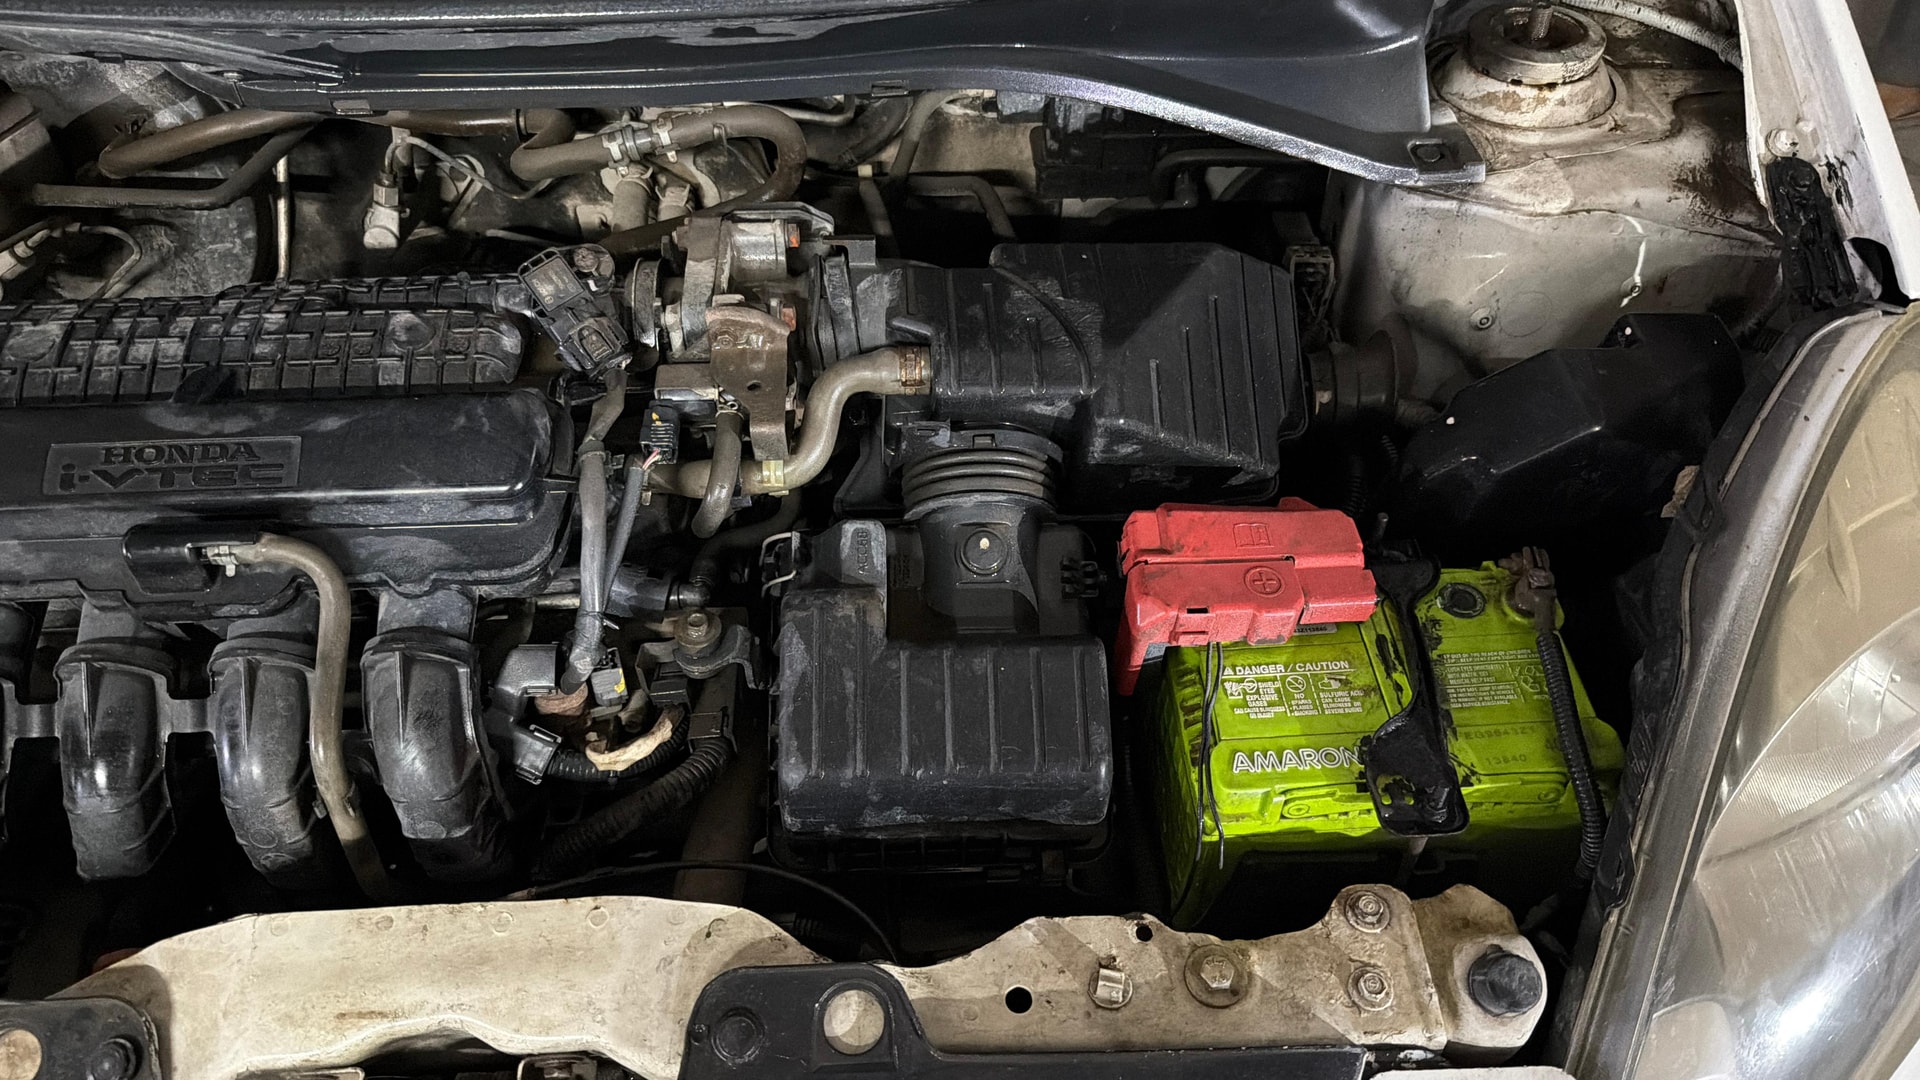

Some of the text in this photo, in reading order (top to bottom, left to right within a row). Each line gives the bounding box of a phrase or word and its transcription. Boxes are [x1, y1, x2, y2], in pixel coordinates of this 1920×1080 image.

[103, 442, 261, 465] HONDA
[59, 463, 285, 492] i-VTEC
[1236, 664, 1285, 675] DANGER
[1296, 661, 1349, 671] CAUTION
[1232, 746, 1364, 773] AMARON
